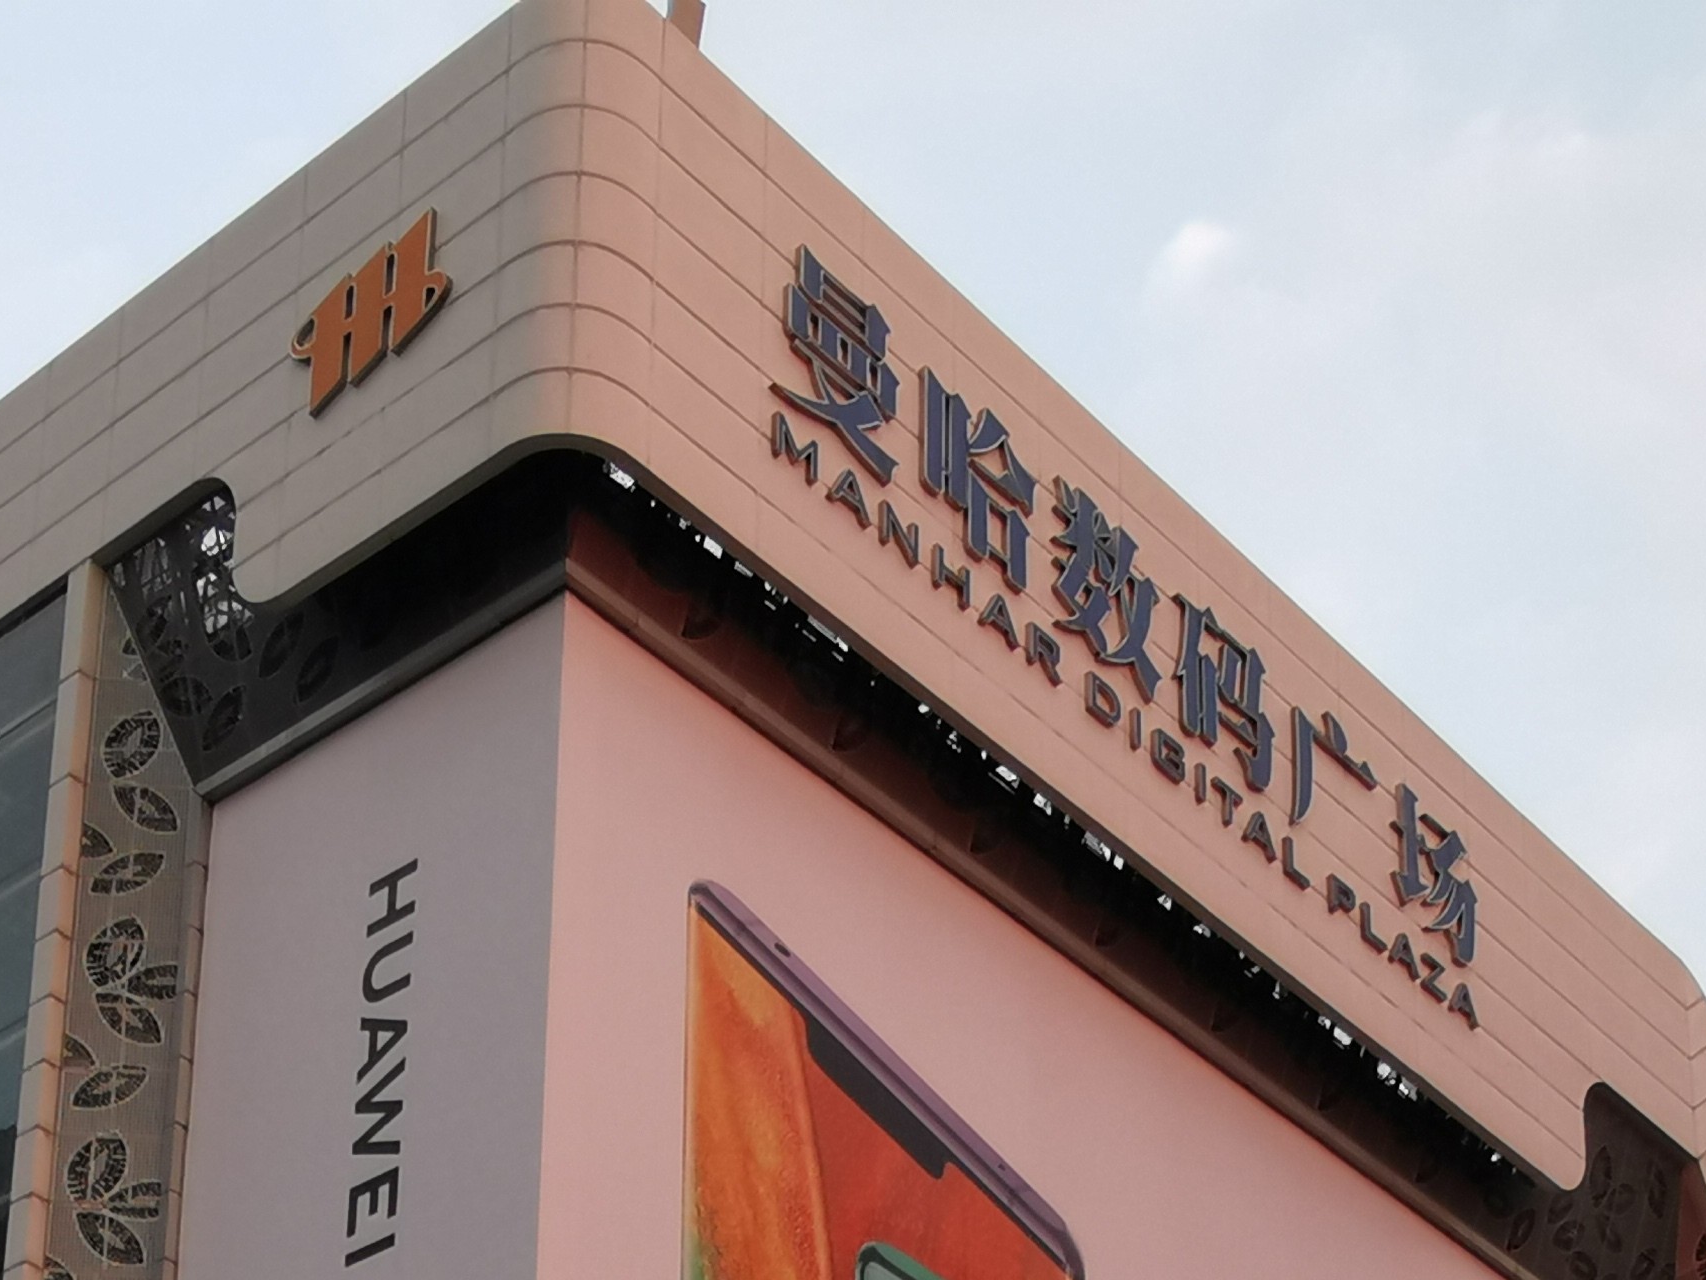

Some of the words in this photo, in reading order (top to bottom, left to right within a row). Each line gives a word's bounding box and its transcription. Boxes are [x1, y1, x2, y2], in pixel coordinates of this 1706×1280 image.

[769, 244, 1477, 967] 曼哈数码广场
[771, 411, 1063, 687] MANHAR
[1084, 671, 1310, 890] DIGITAL
[1326, 874, 1480, 1030] PLAZA
[344, 857, 419, 1268] HUAWEI
